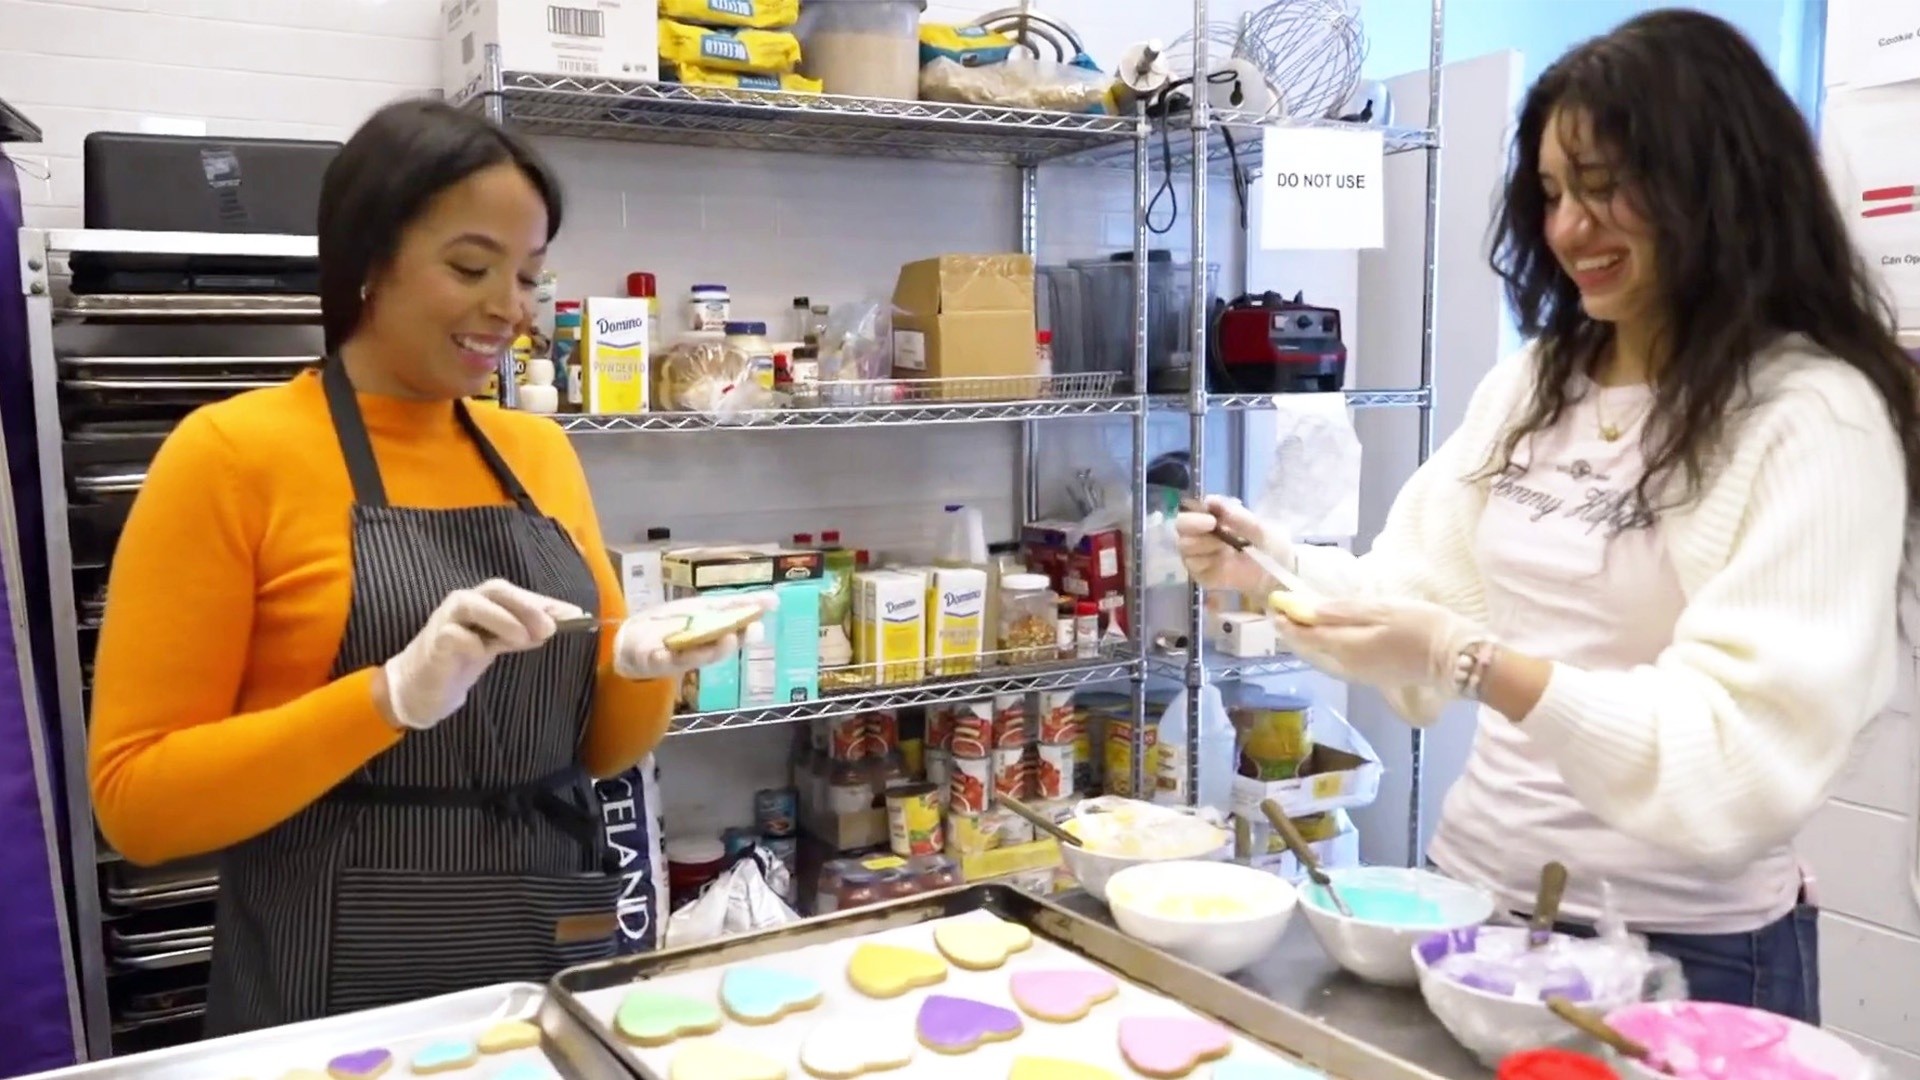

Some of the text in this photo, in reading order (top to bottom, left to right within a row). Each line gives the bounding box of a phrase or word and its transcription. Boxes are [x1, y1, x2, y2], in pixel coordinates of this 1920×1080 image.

[1277, 172, 1365, 189] DO NOT USE
[596, 317, 643, 335] Domino
